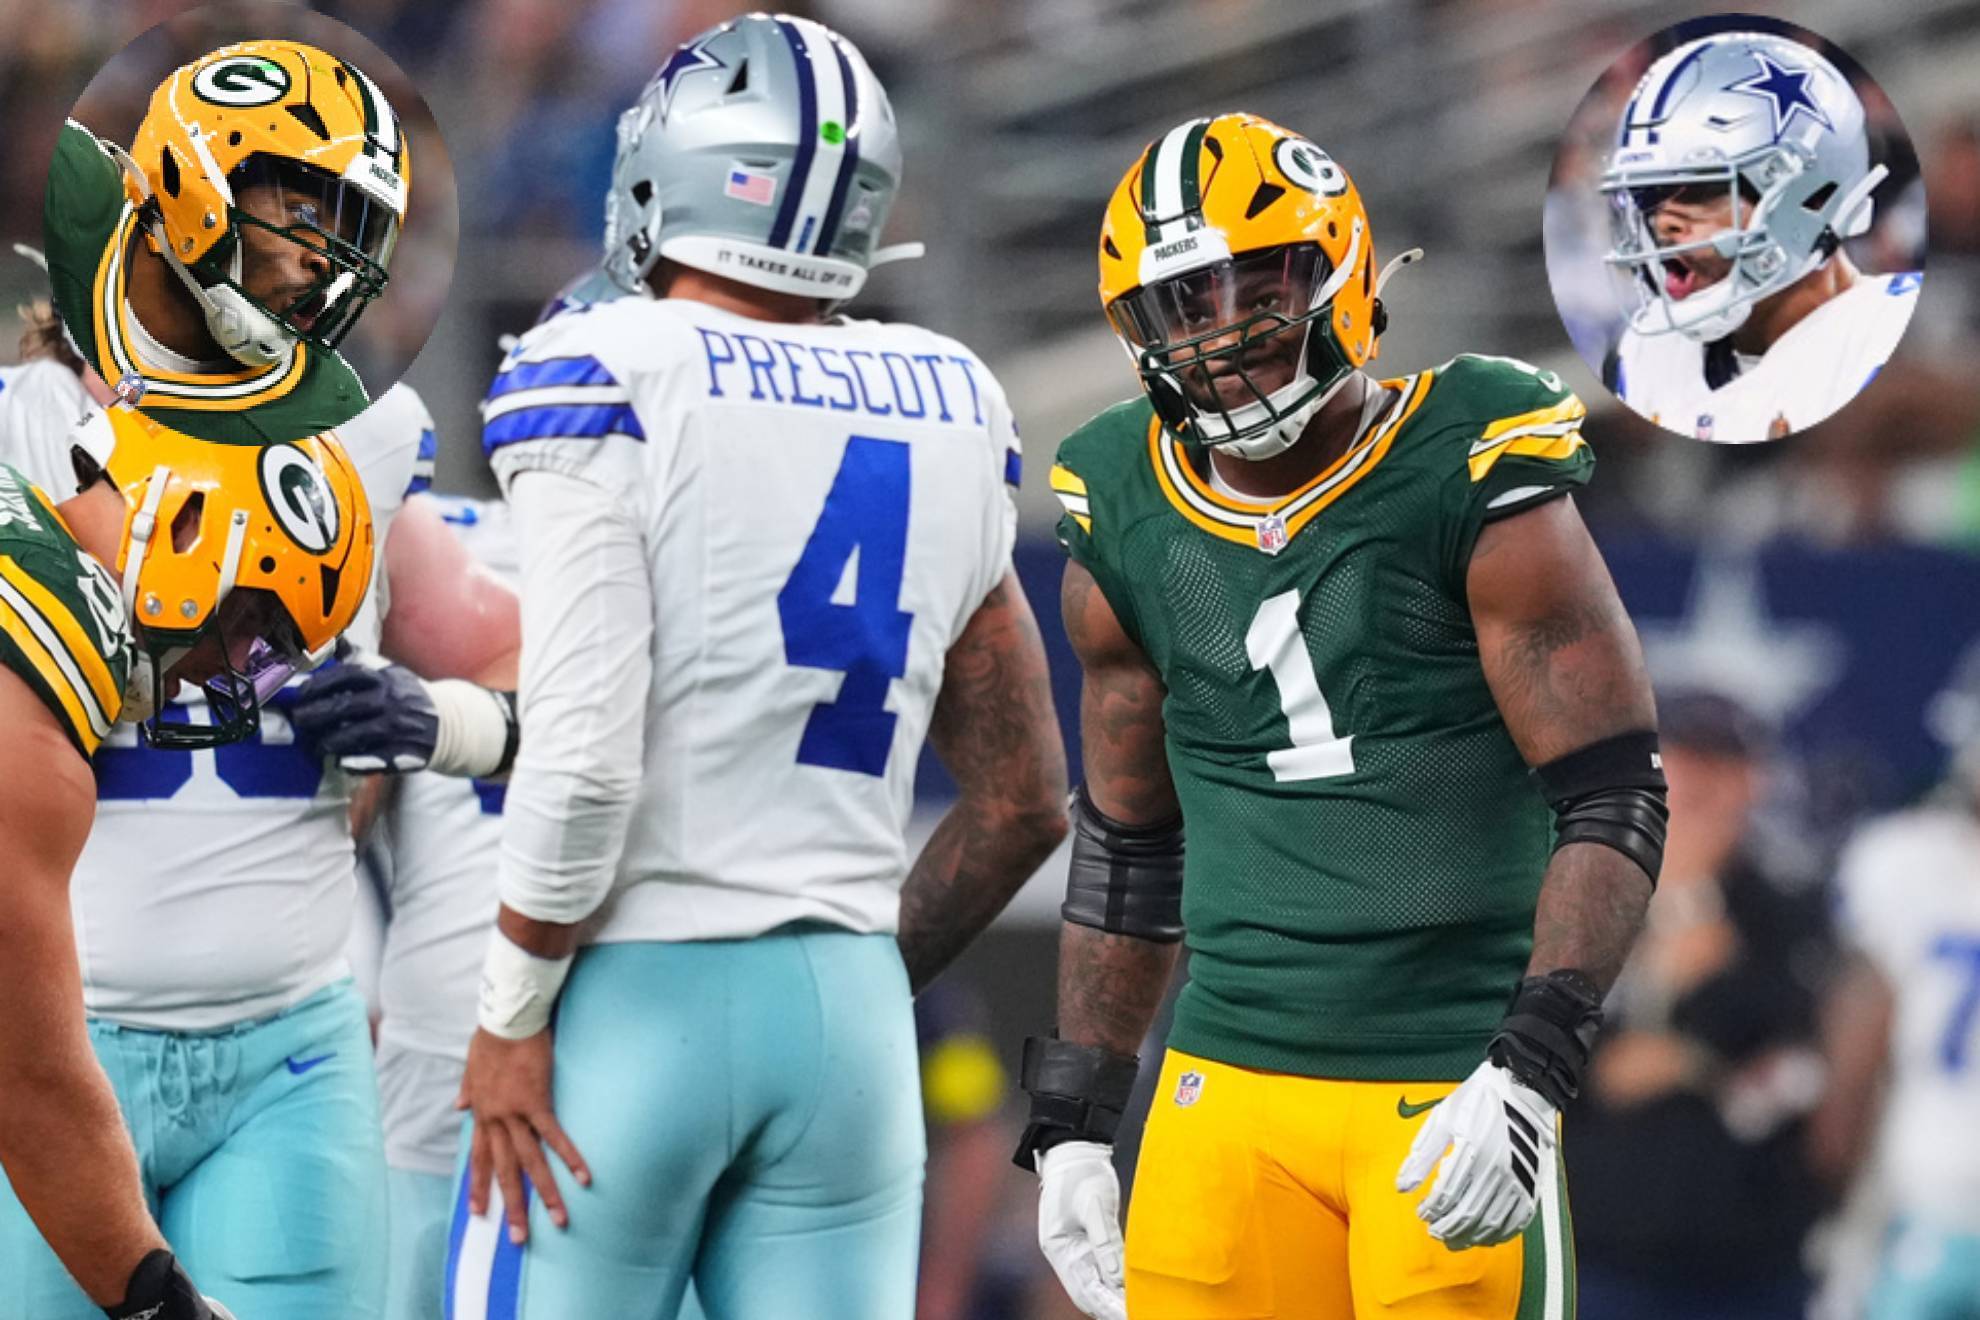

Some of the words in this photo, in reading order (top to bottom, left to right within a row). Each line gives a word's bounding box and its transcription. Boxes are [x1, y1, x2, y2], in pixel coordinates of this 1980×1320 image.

[717, 249, 732, 262] IT
[738, 254, 789, 275] TAKES
[791, 267, 816, 282] ALL
[820, 271, 837, 284] OF
[1153, 236, 1199, 262] PACKERS
[694, 326, 984, 426] PRESCOTT
[777, 434, 915, 778] 4
[1244, 587, 1357, 783] 1
